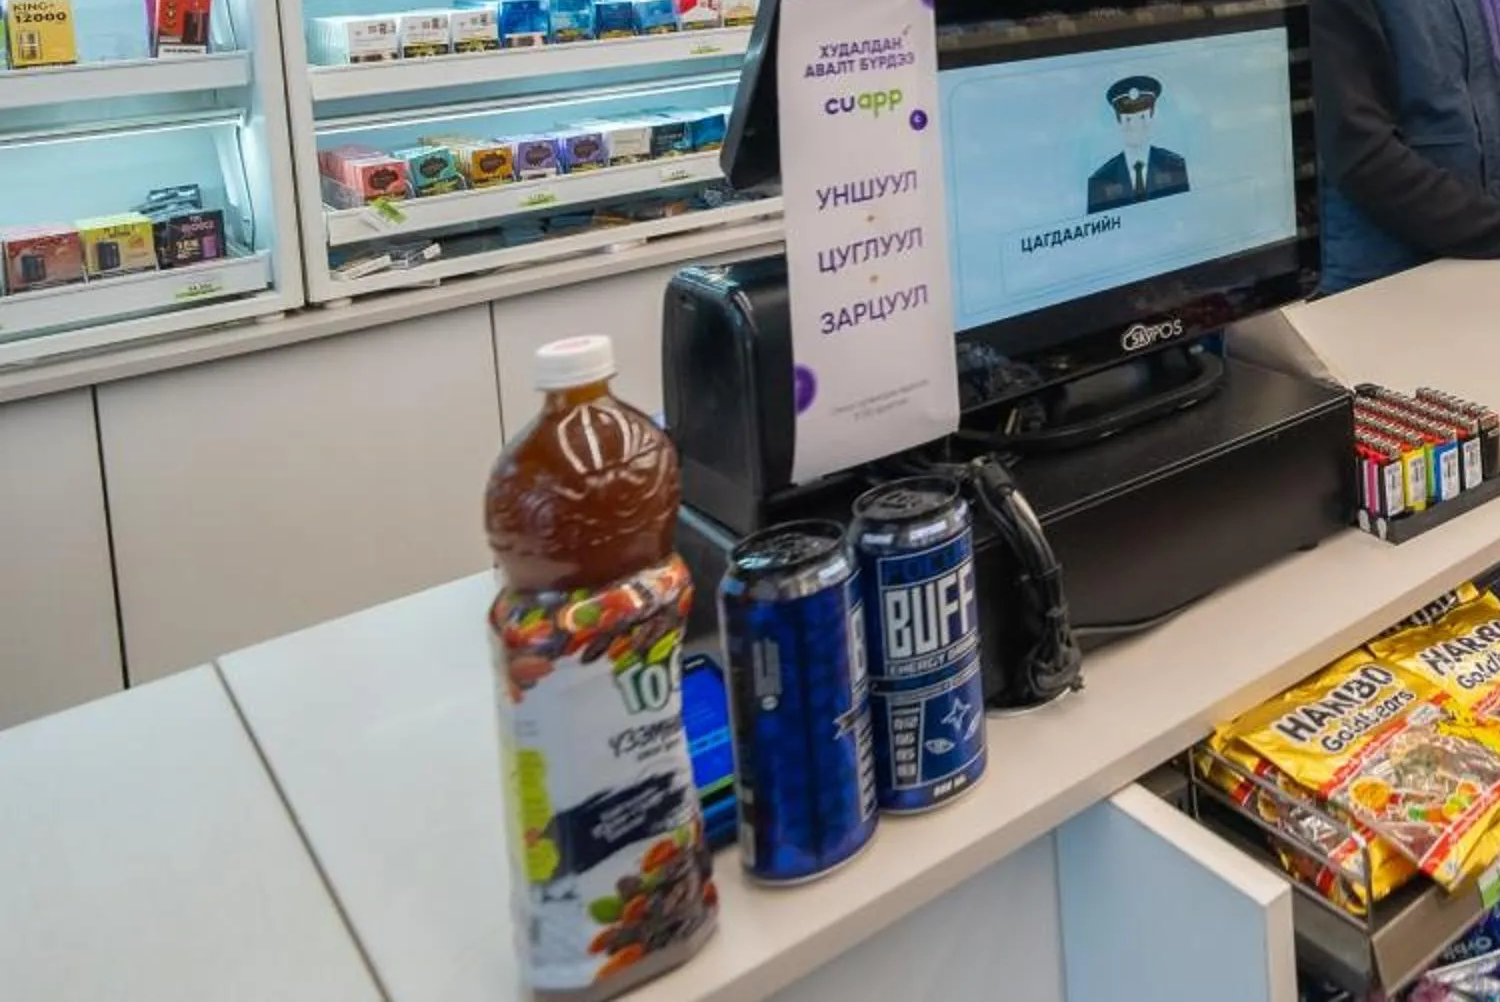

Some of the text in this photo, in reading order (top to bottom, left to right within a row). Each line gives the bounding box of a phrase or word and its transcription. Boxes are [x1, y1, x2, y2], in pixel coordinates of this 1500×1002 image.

[804, 59, 855, 78] АВАЛТ
[819, 37, 903, 59] ХУДАЛДАН
[816, 170, 918, 211] УНШУУЛ
[818, 226, 923, 273] ЦУГЛУУЛ
[1020, 215, 1122, 254] ЦАГДААГИЙН
[820, 284, 929, 335] ЗАРЦУУЛ
[884, 559, 974, 660] BUFF
